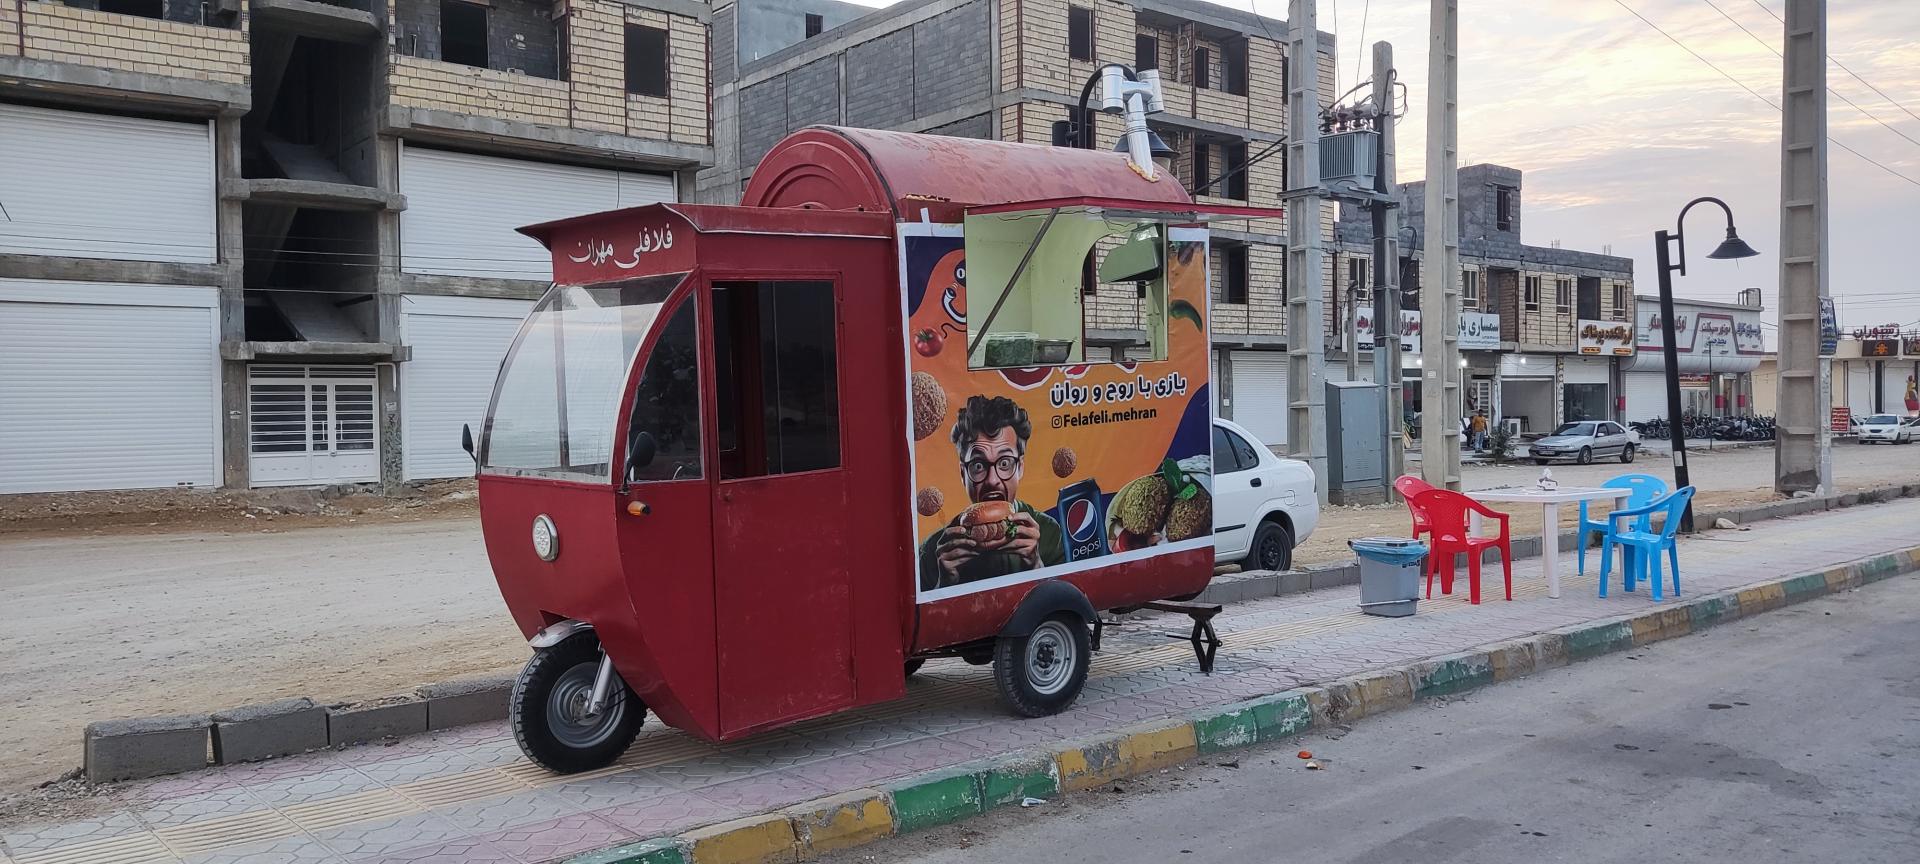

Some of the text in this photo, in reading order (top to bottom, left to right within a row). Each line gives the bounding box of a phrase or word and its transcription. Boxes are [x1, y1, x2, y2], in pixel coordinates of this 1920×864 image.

[567, 222, 673, 269] فلافلی مهران
[1853, 325, 1900, 338] رستوران
[1051, 372, 1187, 406] بازی با روح و روان
[1063, 408, 1157, 428] Felafeli.mehran
[1072, 537, 1102, 560] pepsi
